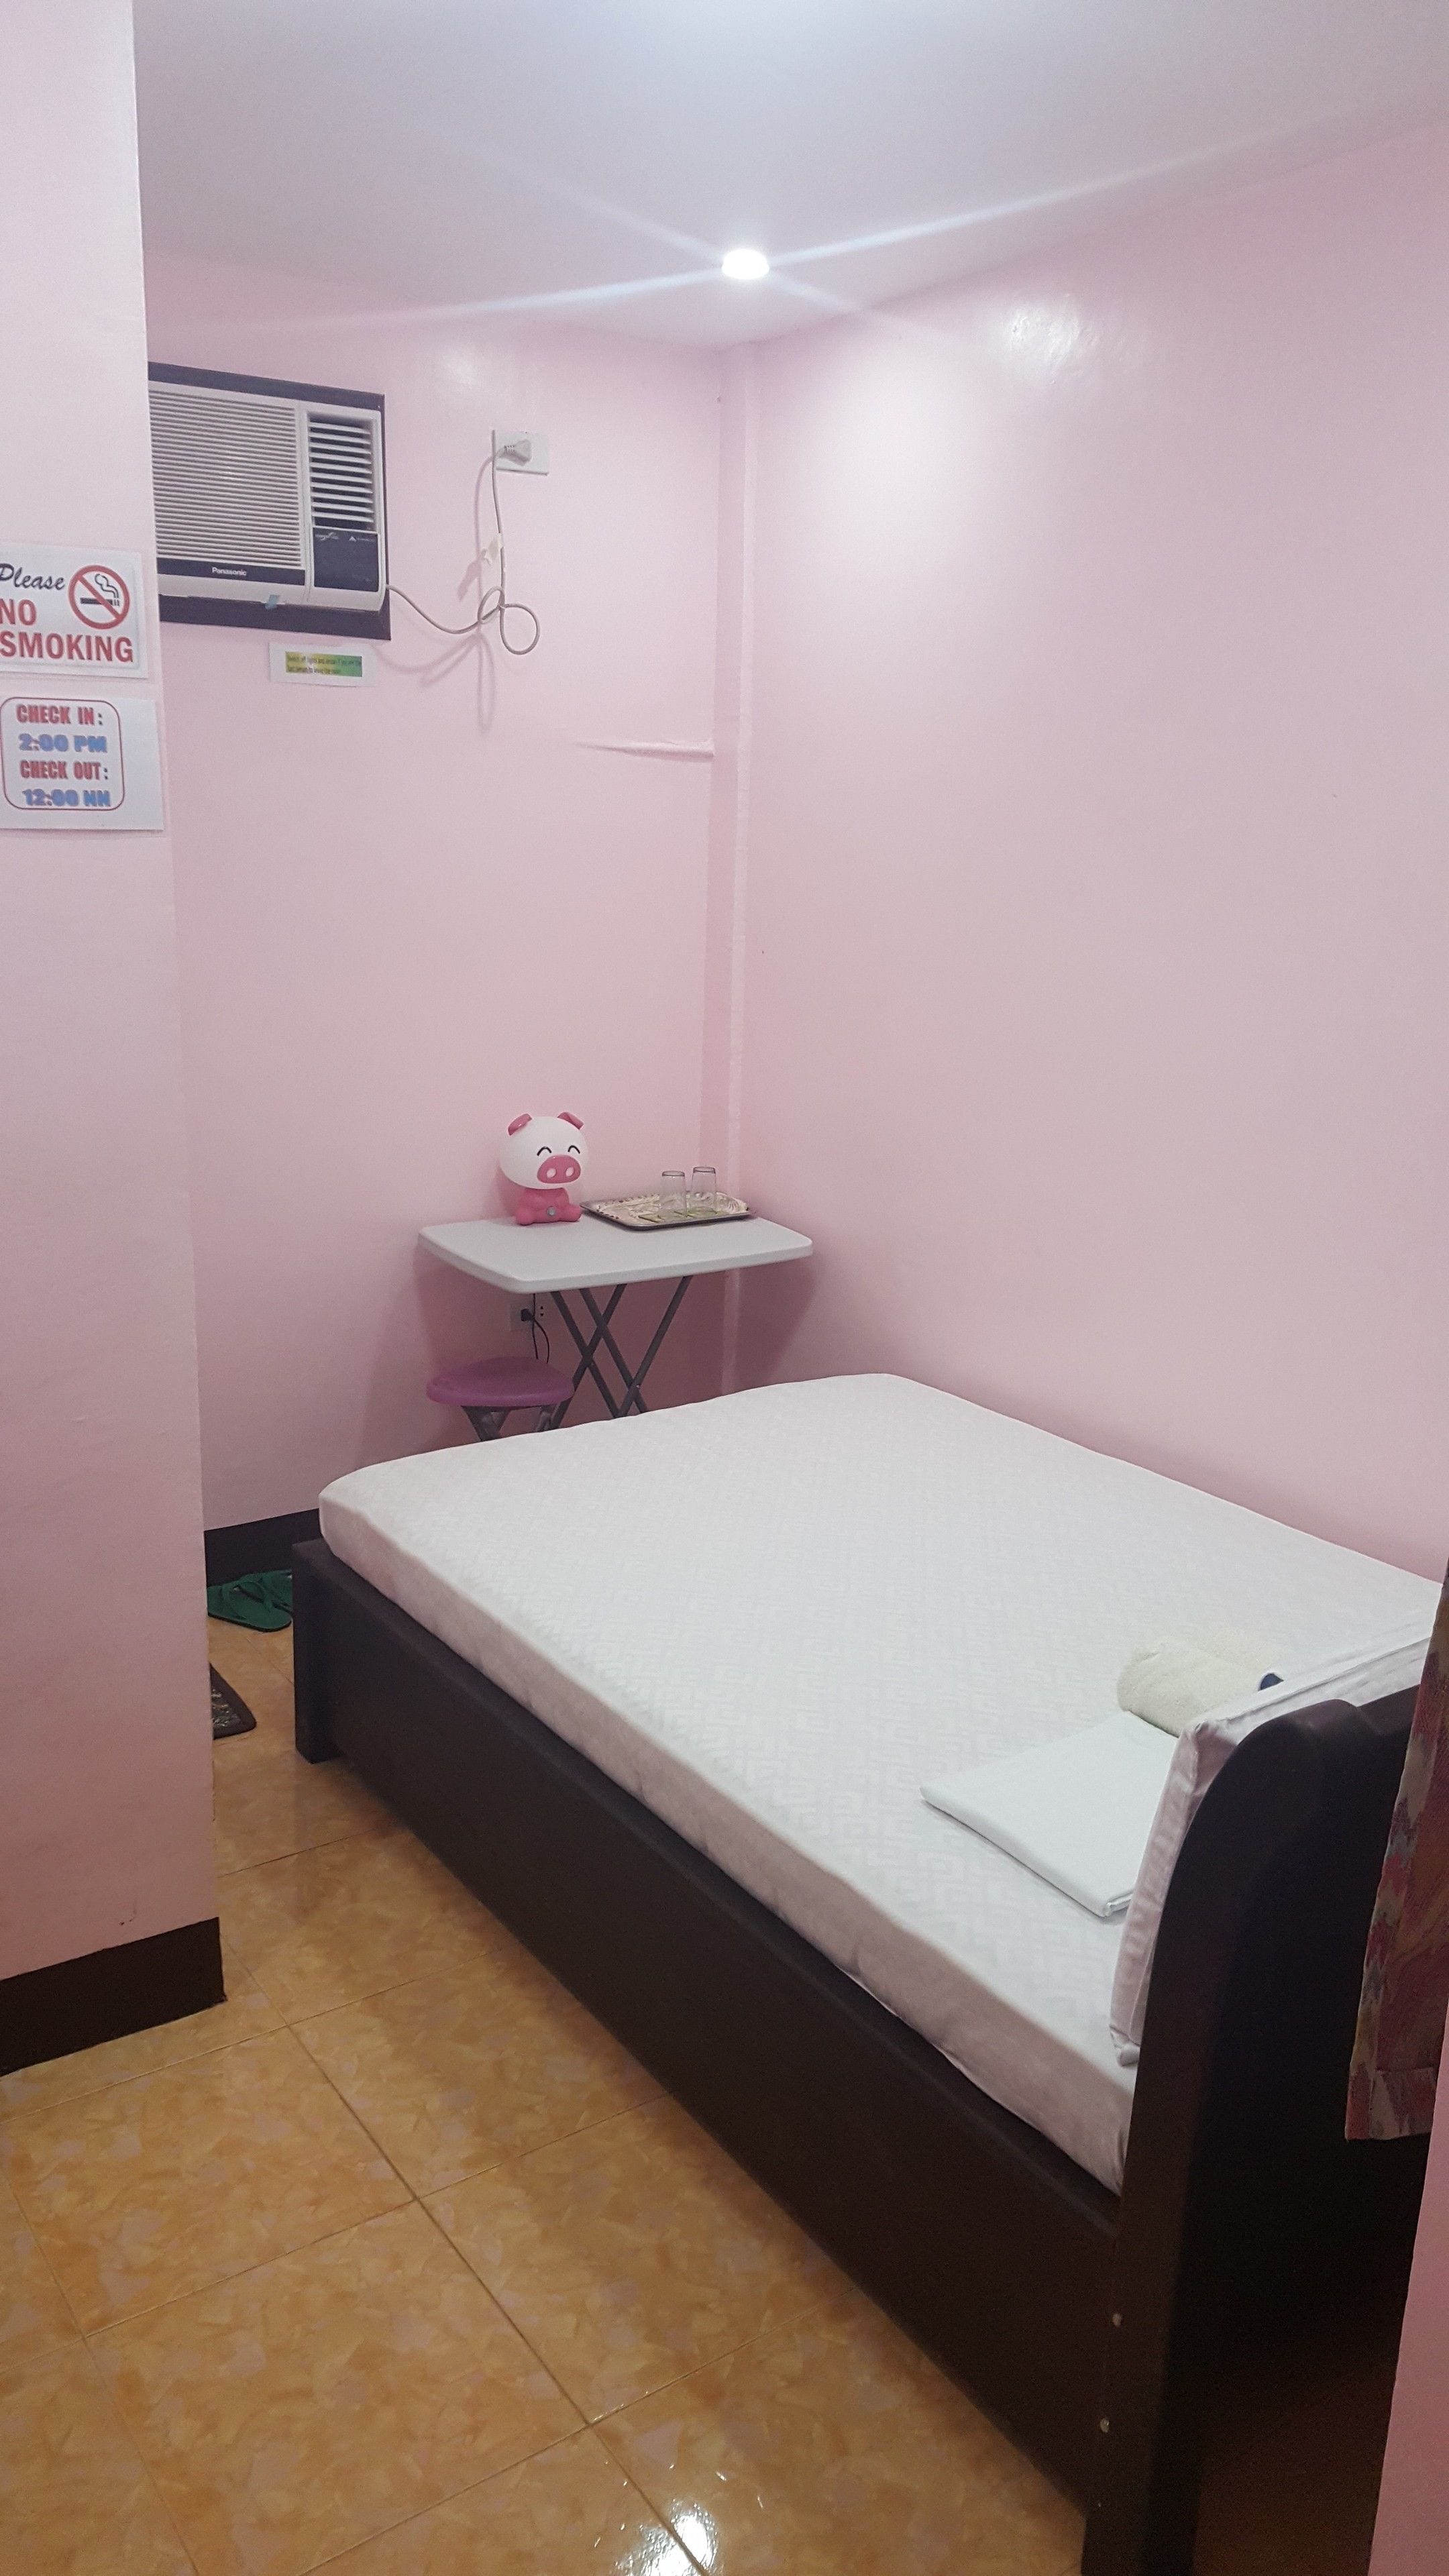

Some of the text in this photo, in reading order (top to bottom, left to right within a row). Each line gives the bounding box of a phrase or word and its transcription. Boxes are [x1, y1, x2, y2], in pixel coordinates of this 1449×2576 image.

[0, 563, 65, 590] Please
[212, 567, 247, 576] Panasonic
[0, 598, 37, 626] NO
[0, 631, 133, 662] SMOKING
[16, 704, 71, 724] CHECK
[18, 733, 107, 753] 2:00 PM
[19, 760, 68, 780] CHECK
[22, 789, 111, 807] 12:00 NN
